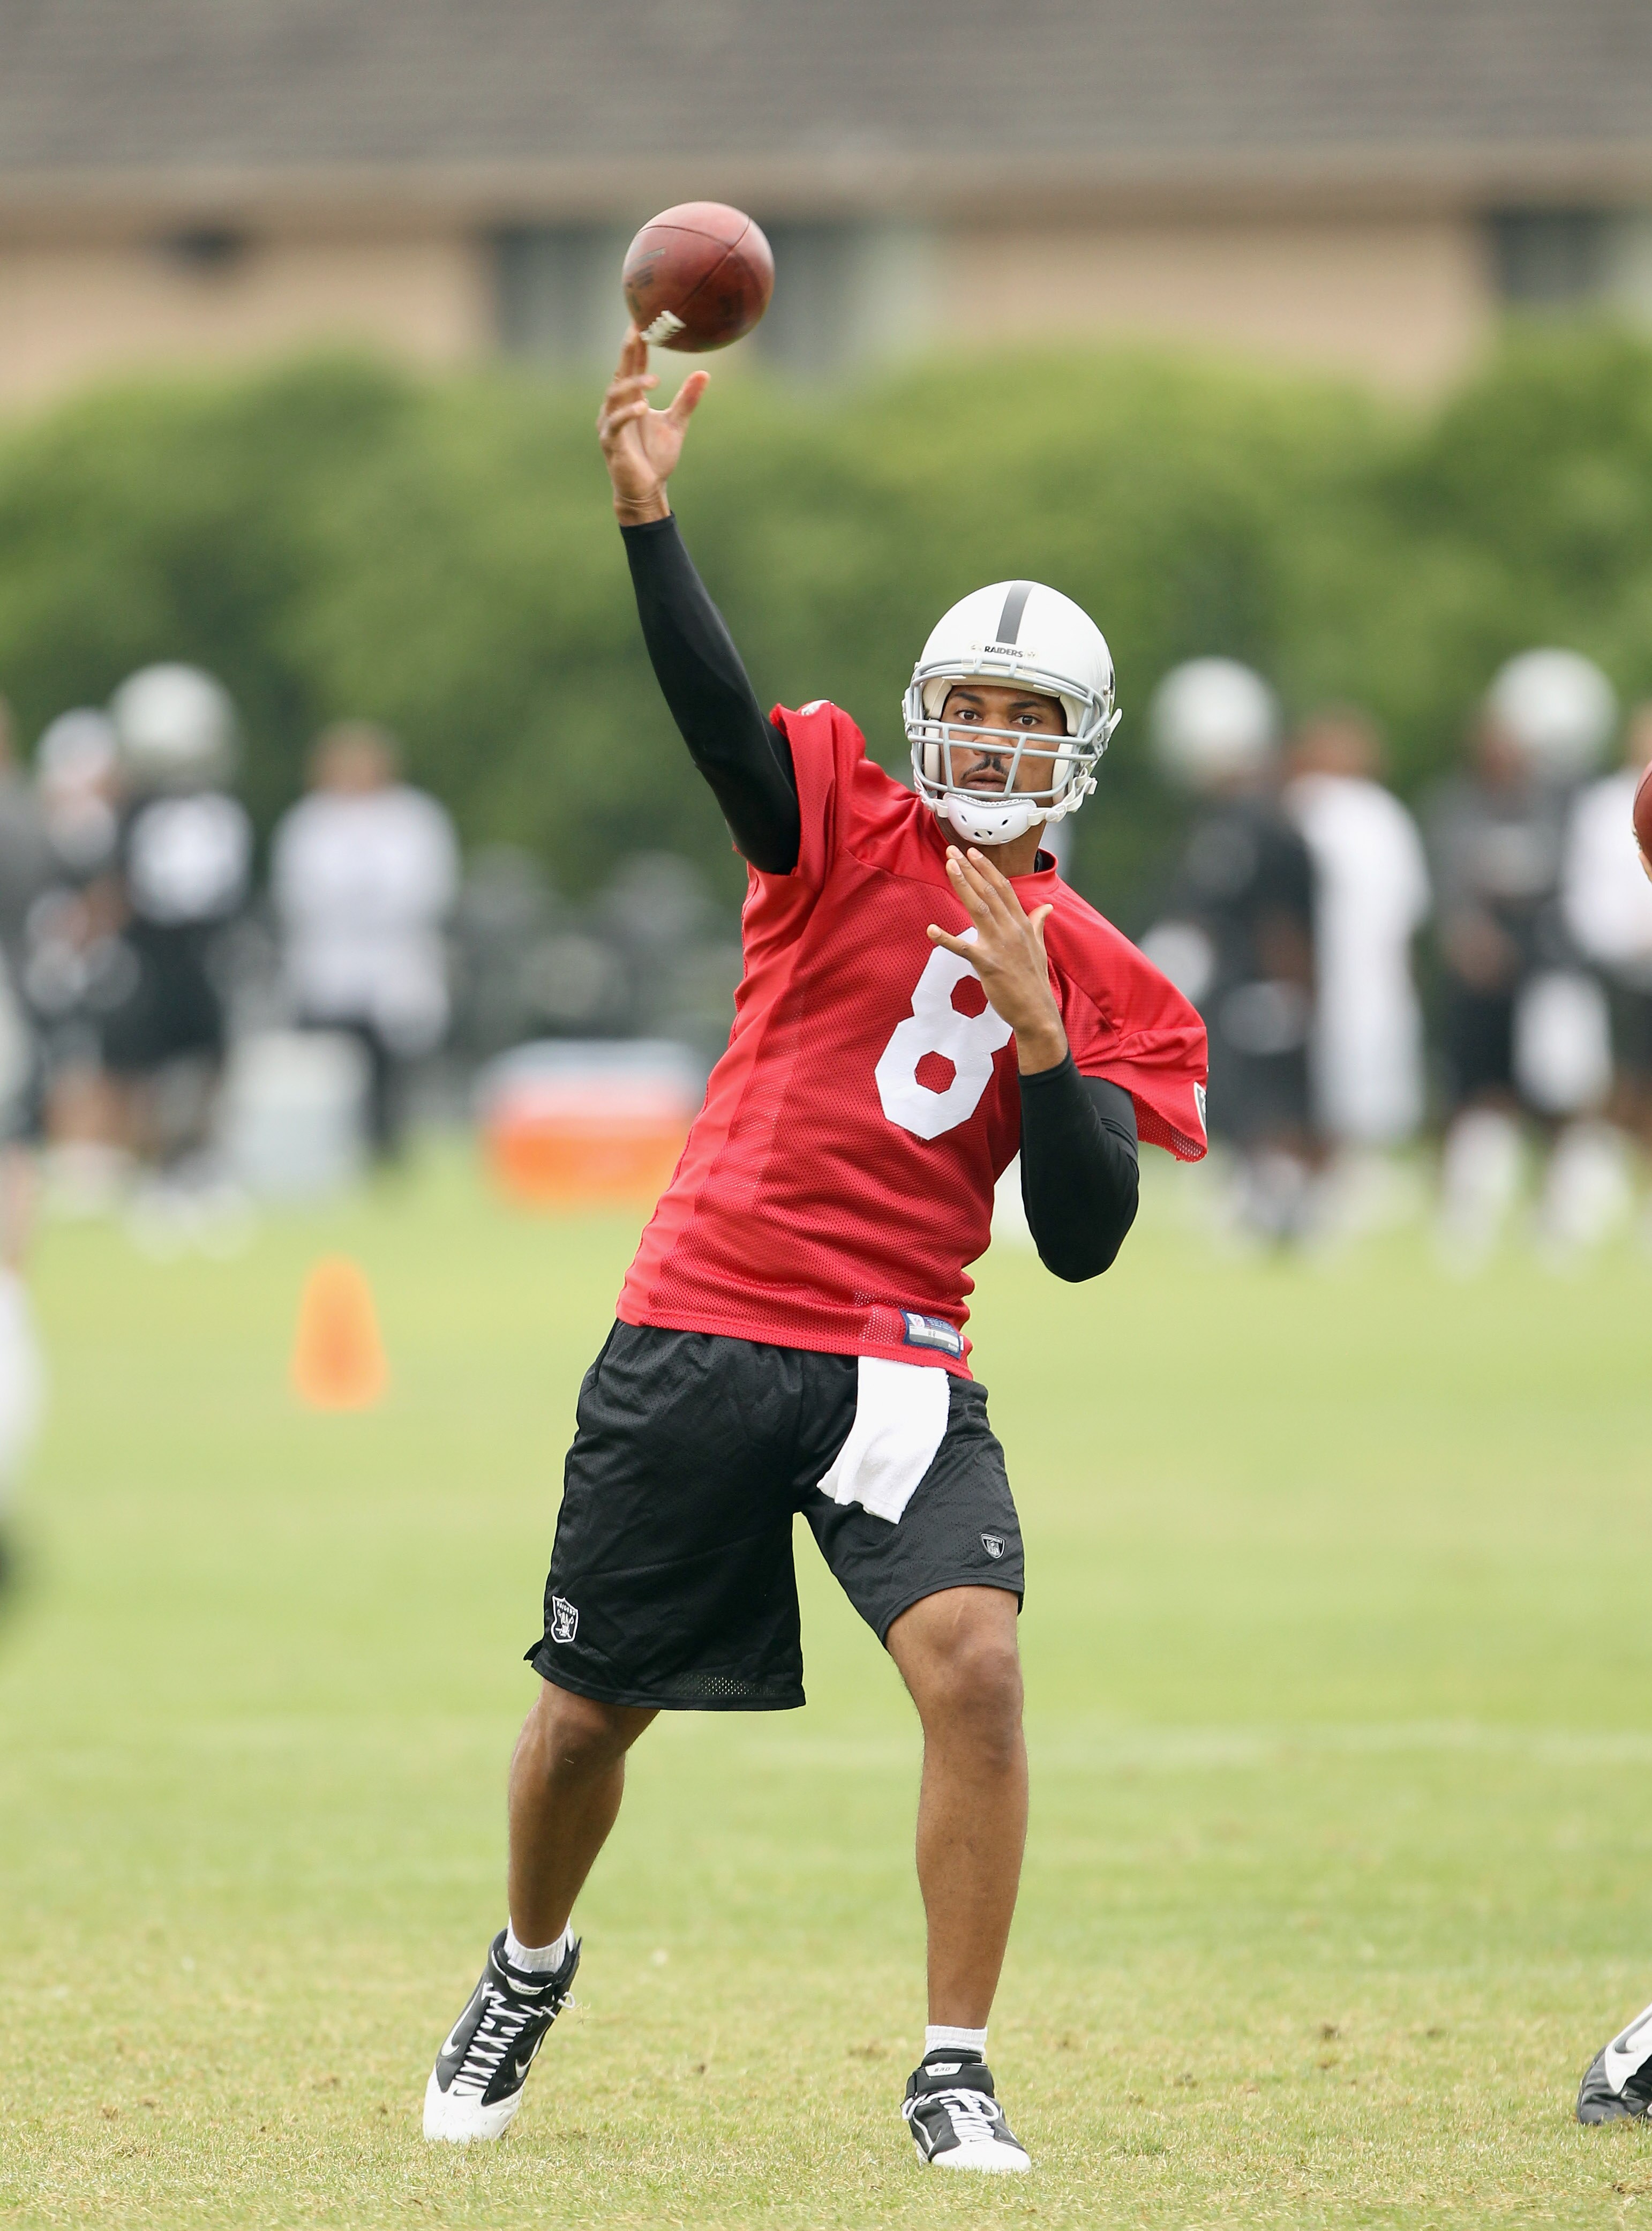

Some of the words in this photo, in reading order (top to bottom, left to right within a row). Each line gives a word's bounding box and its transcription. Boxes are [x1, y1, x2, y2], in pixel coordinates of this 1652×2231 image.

[985, 646, 1024, 657] RAIDERS
[874, 926, 1013, 1141] 8
[557, 1600, 576, 1616] RAIDERS
